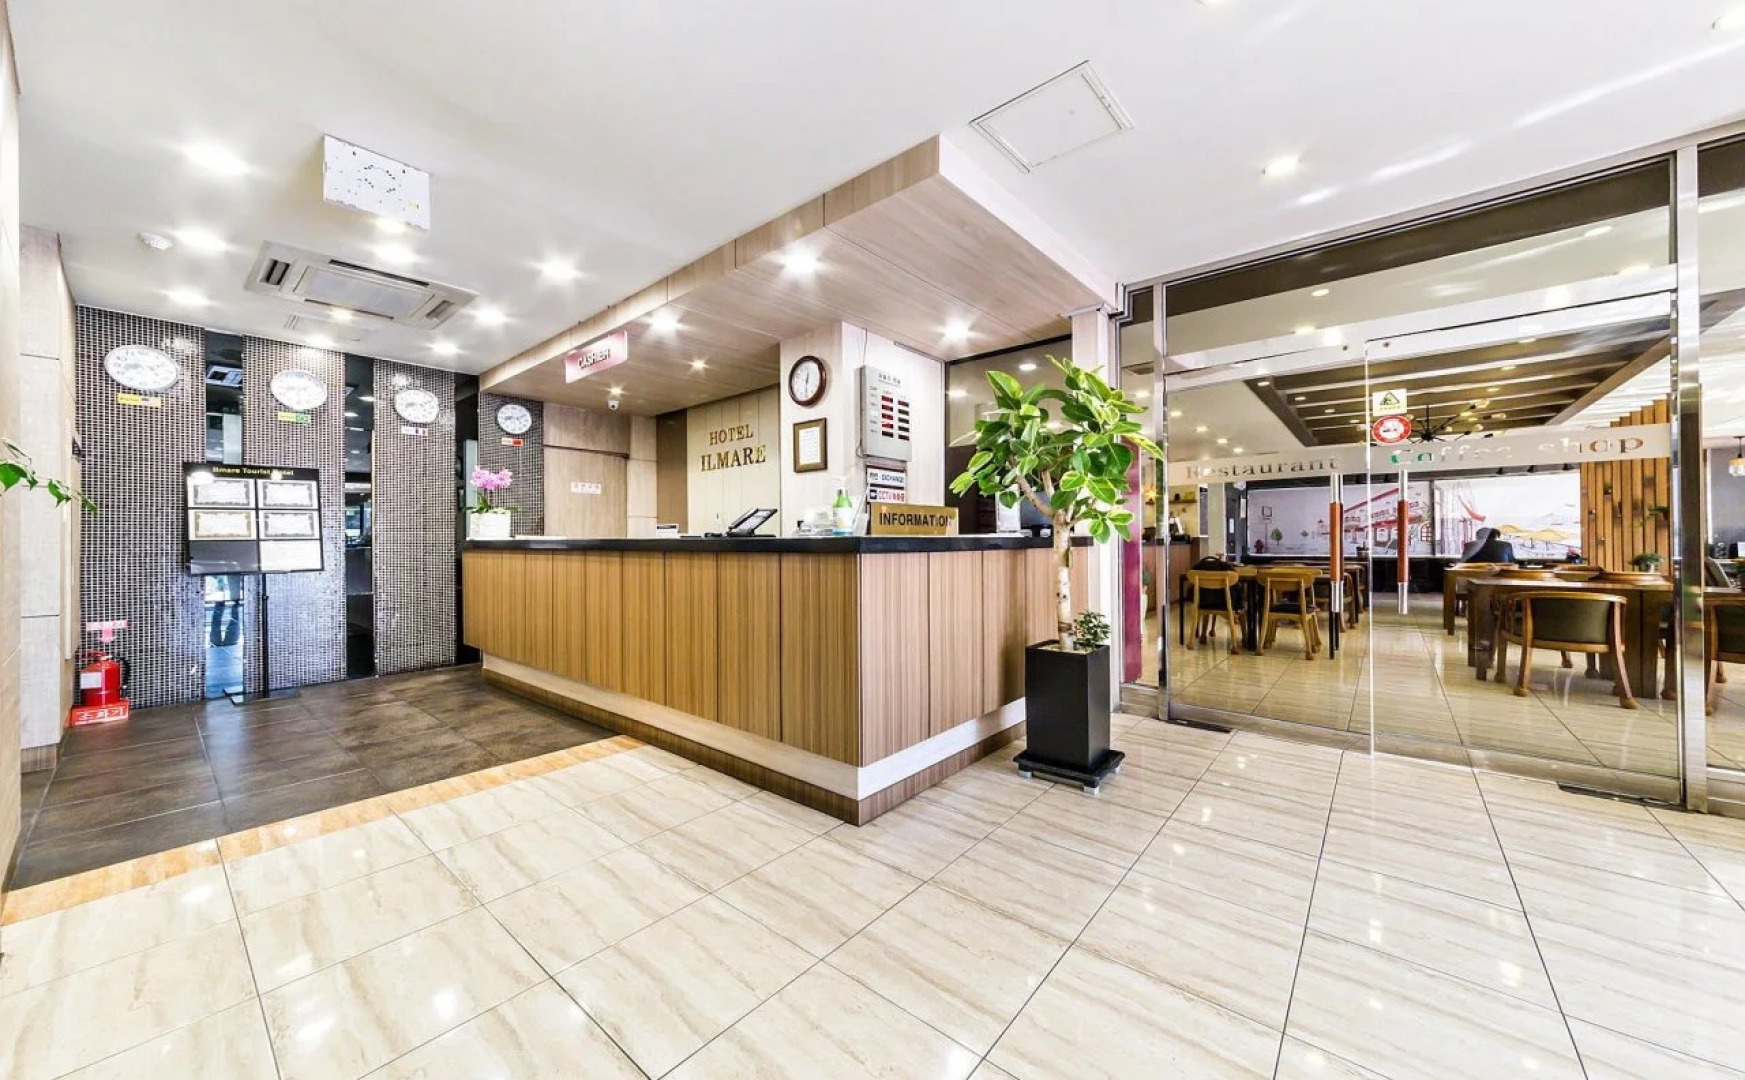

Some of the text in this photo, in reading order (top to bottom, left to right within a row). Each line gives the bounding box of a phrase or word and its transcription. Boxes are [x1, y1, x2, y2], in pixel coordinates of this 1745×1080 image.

[709, 423, 754, 446] HOTEL
[701, 444, 766, 472] ILMARE
[1185, 456, 1339, 479] Rstaurant
[272, 468, 294, 476] otel
